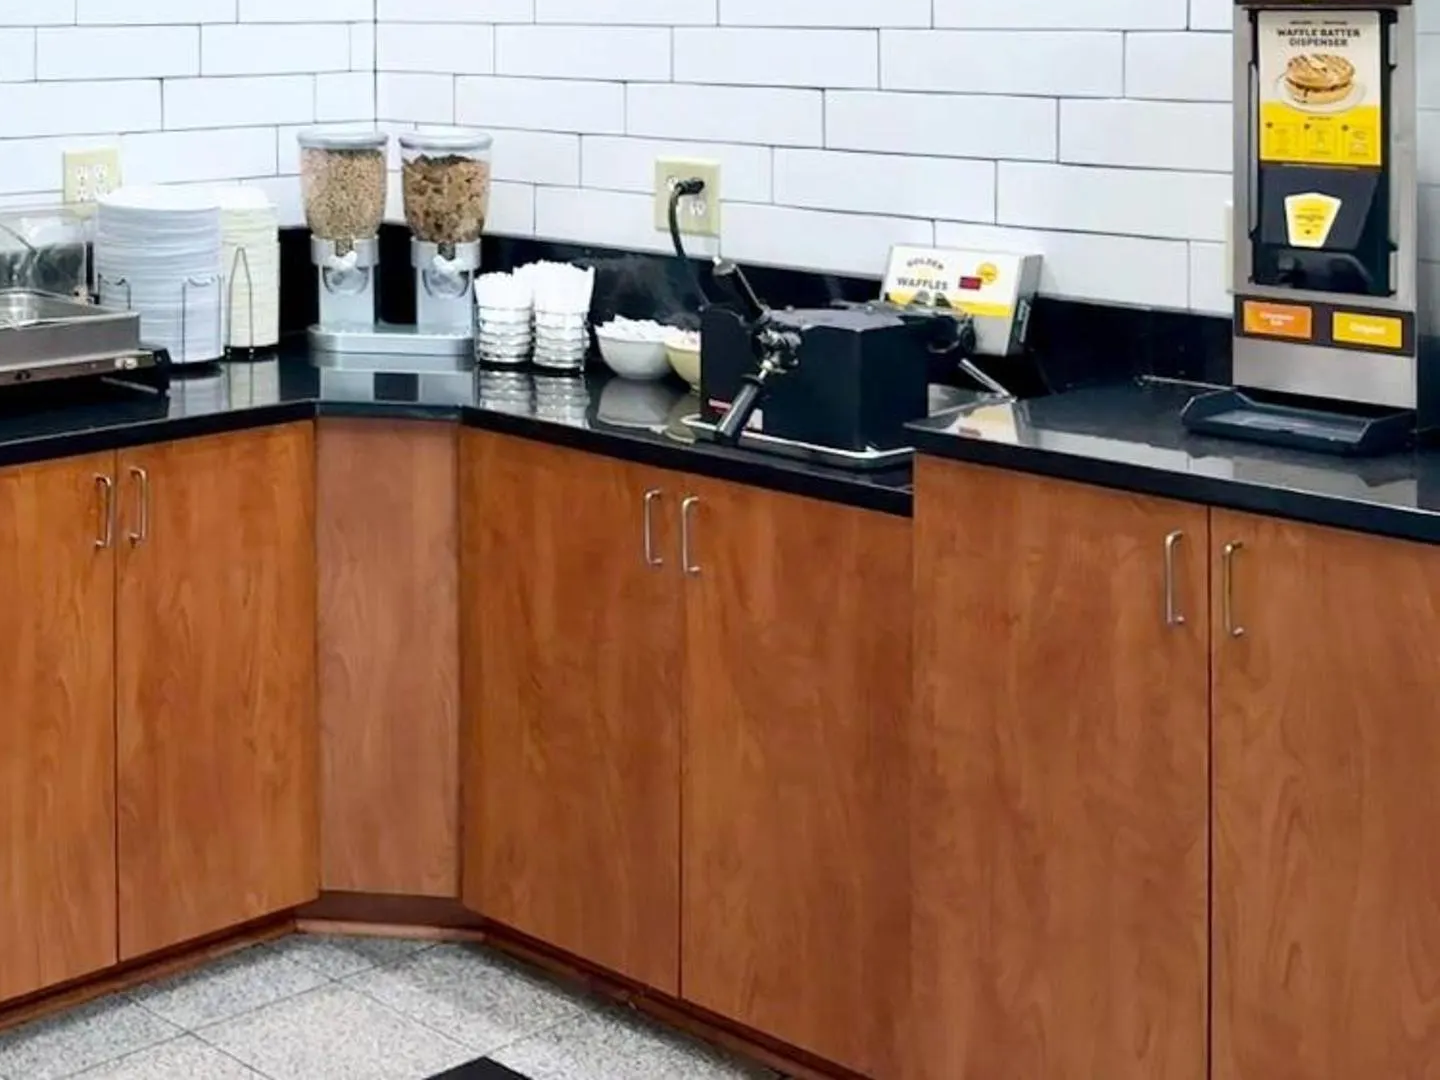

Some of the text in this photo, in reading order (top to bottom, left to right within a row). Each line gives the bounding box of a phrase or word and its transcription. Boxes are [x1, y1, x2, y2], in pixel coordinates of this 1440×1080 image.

[1277, 28, 1361, 37] WAFFLE BATTER
[1289, 38, 1348, 47] DISPENSER
[897, 276, 948, 291] WAFFLES
